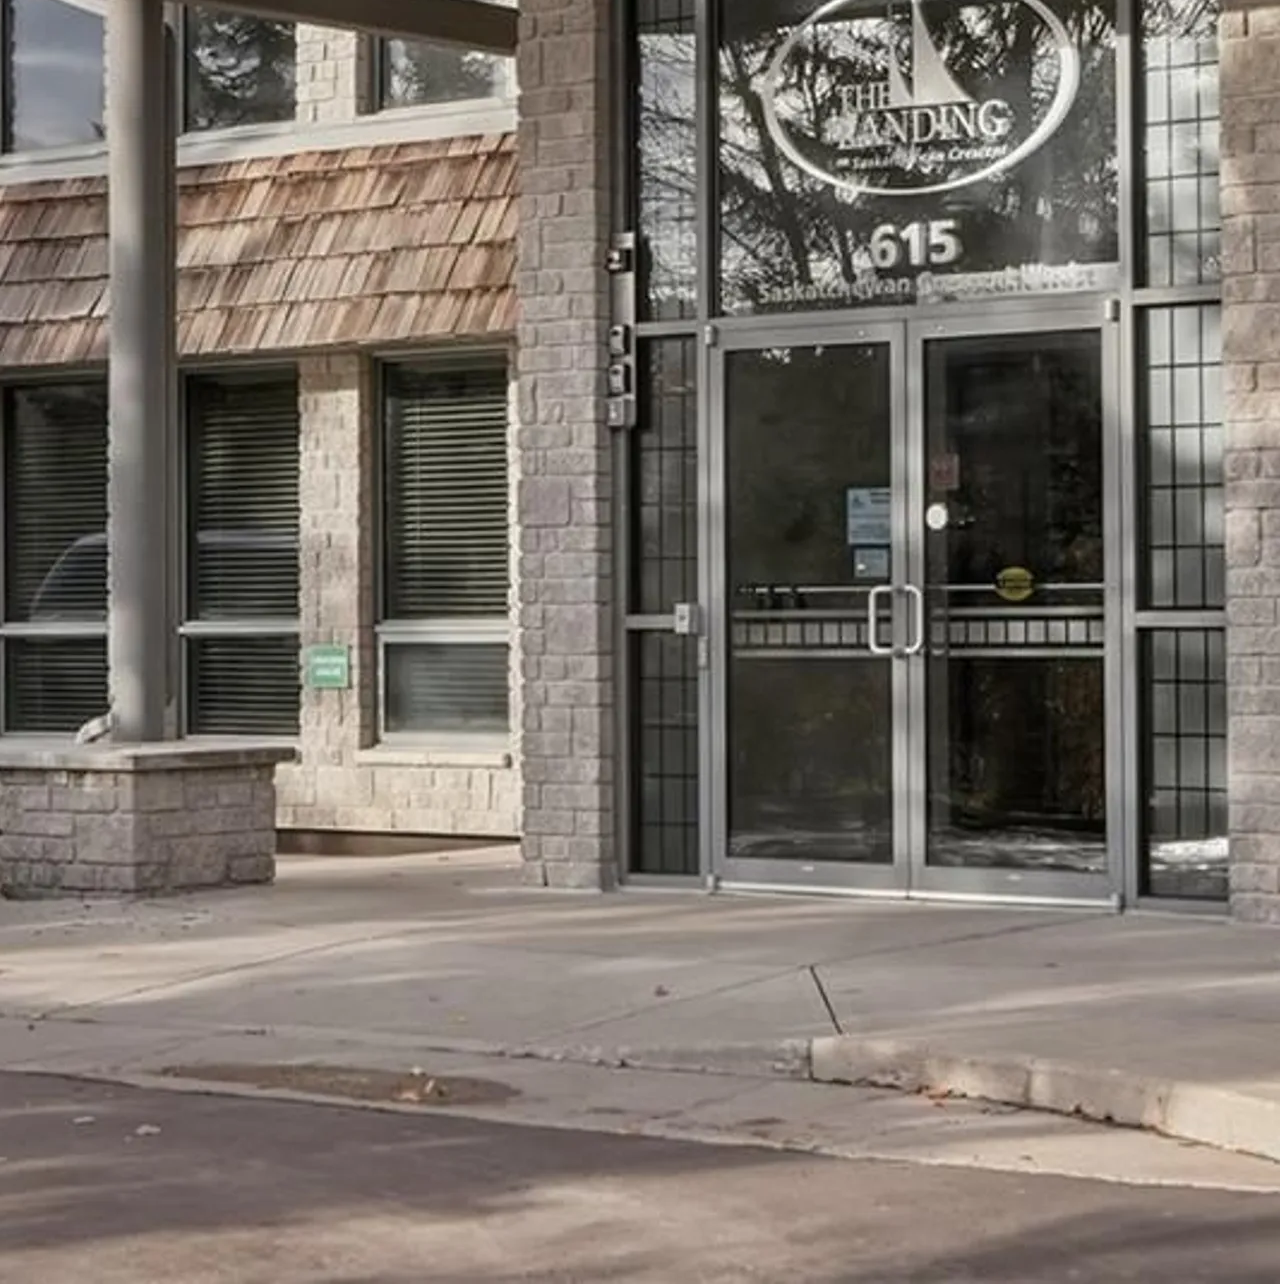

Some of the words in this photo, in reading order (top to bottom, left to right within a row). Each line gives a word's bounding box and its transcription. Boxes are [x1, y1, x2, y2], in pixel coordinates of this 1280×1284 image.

[835, 82, 892, 115] THE
[838, 98, 1014, 150] LANDING
[870, 220, 962, 268] 615
